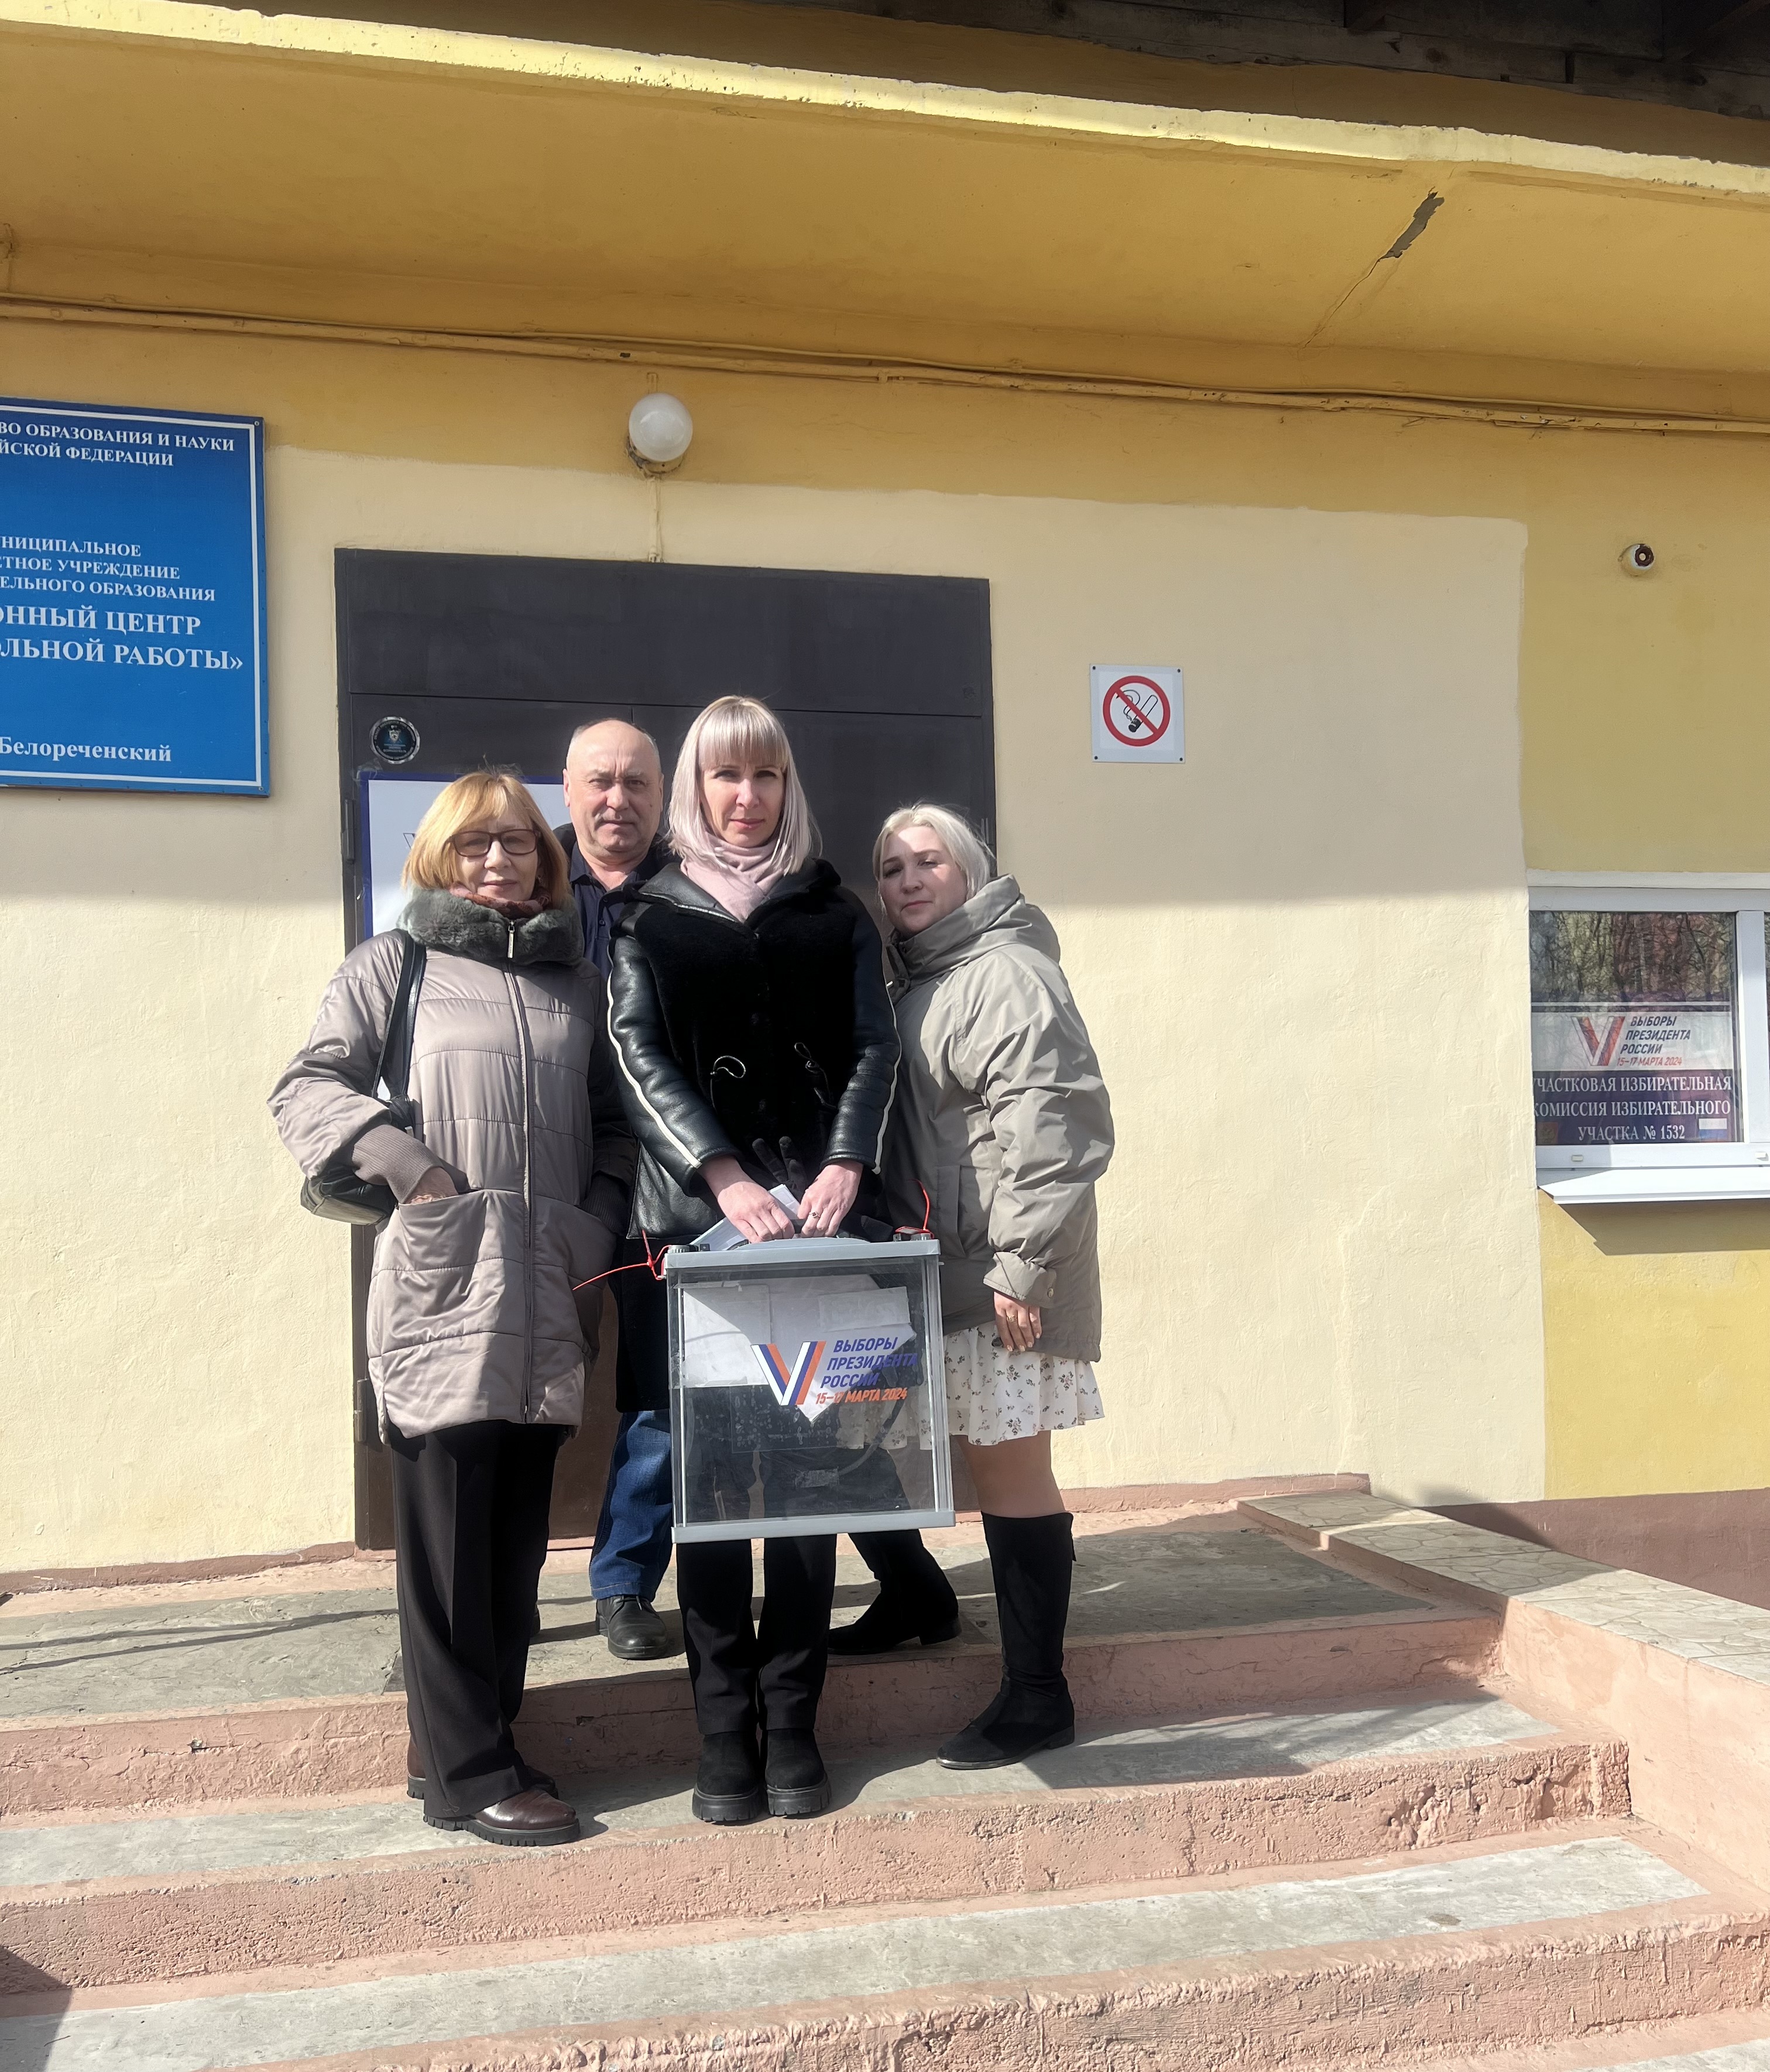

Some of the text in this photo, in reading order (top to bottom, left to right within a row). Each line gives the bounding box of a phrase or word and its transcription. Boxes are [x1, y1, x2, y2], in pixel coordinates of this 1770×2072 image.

[0, 422, 234, 451] ВО ОБРАЗОВАНИЯ И НАУКИ
[0, 439, 174, 466] ЙСКОЙ ФЕДЕРАЦИИ
[0, 536, 141, 557] НИЦИПАЛЬНОЕ
[0, 556, 180, 579] ТНОЕ УЧРЕЖДЕНИЕ
[0, 576, 215, 602] ЕЛЬНОГО ОБРАЗОВАНИЯ
[0, 605, 201, 636] ННЫЙ ЦЕНТР
[0, 637, 243, 670] ЛЬНОЙ РАБОТЫ»
[0, 736, 171, 761] Белореченский
[1631, 1016, 1677, 1027] ВЫБОРЫ
[1625, 1030, 1691, 1041] ПРЕЗИДЕНТА
[1620, 1044, 1663, 1054] РОССИИ
[1638, 1056, 1663, 1066] МАРТА
[1664, 1056, 1683, 1066] 2024
[1621, 1076, 1731, 1092] ИЗБИРАТЕЛЬНАЯ
[1611, 1100, 1731, 1117] ИЗБИРАТЕЛЬНОГО
[1578, 1125, 1685, 1141] УЧАСТКА № 1532
[833, 1337, 898, 1353] ВЫБОРЫ
[826, 1353, 918, 1371] ПРЕЗИДЕНТА
[820, 1373, 880, 1388] РОССИИ
[845, 1389, 879, 1403] МАРТА
[881, 1388, 908, 1401] 2024
